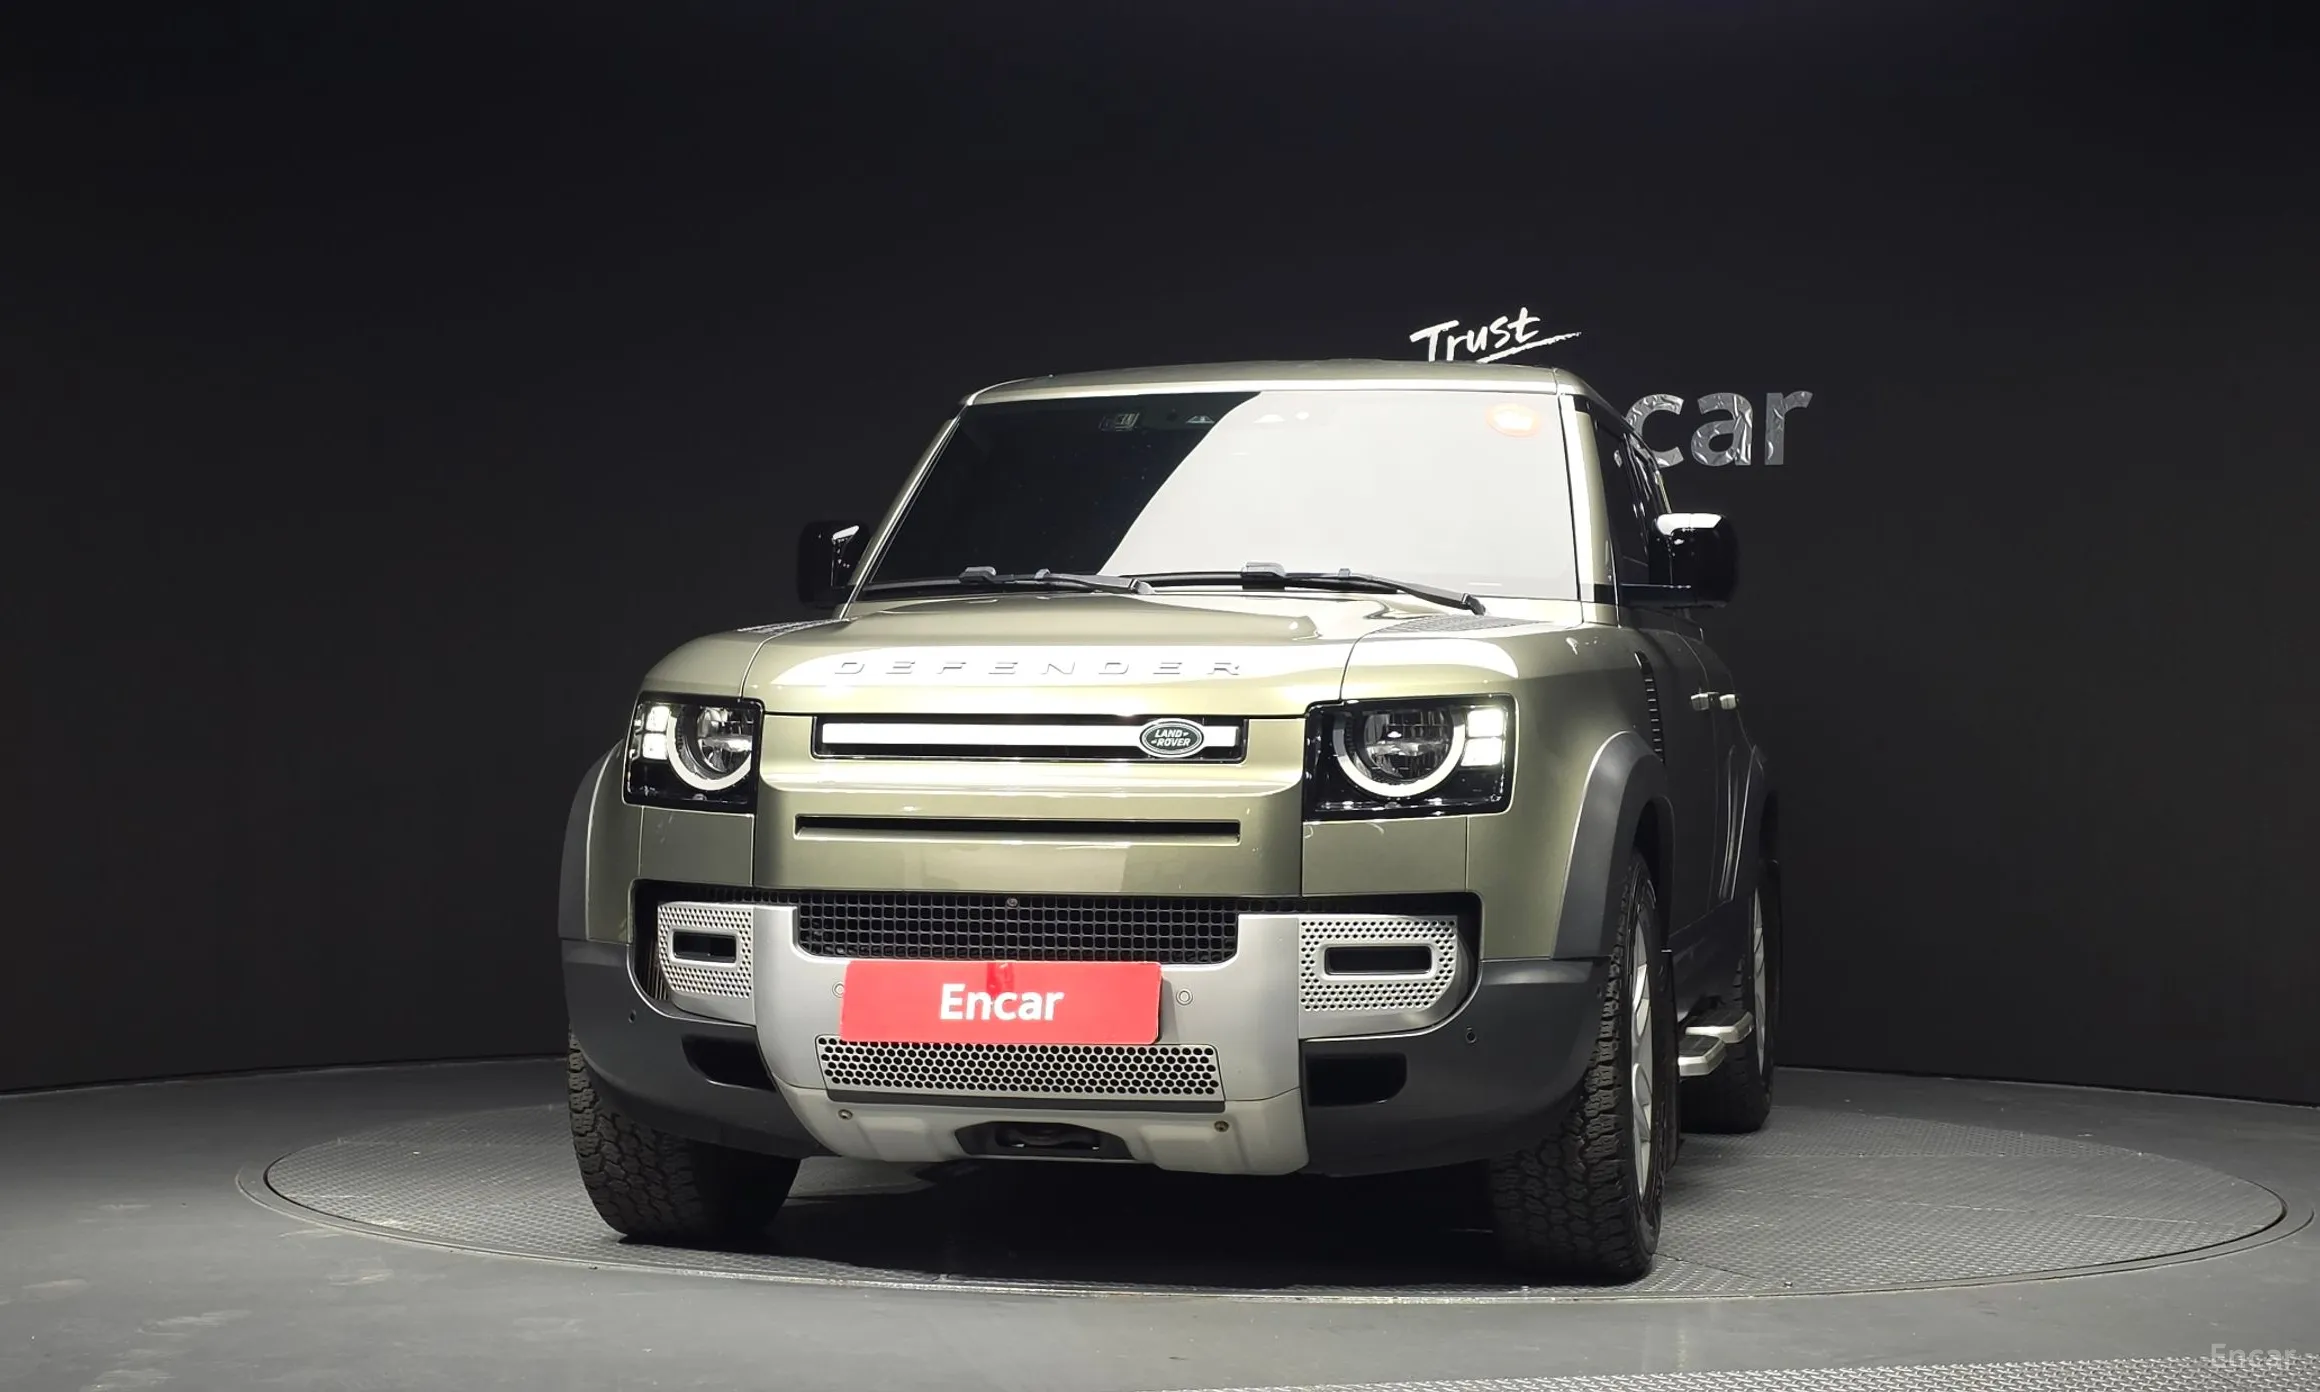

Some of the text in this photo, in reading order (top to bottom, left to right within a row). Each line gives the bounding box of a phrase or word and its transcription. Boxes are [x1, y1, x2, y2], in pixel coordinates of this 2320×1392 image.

[1409, 306, 1541, 362] Trust
[834, 660, 1240, 676] DEFENDER
[1154, 728, 1183, 738] LAND
[1156, 737, 1191, 747] ROVER
[939, 983, 1065, 1021] Encar
